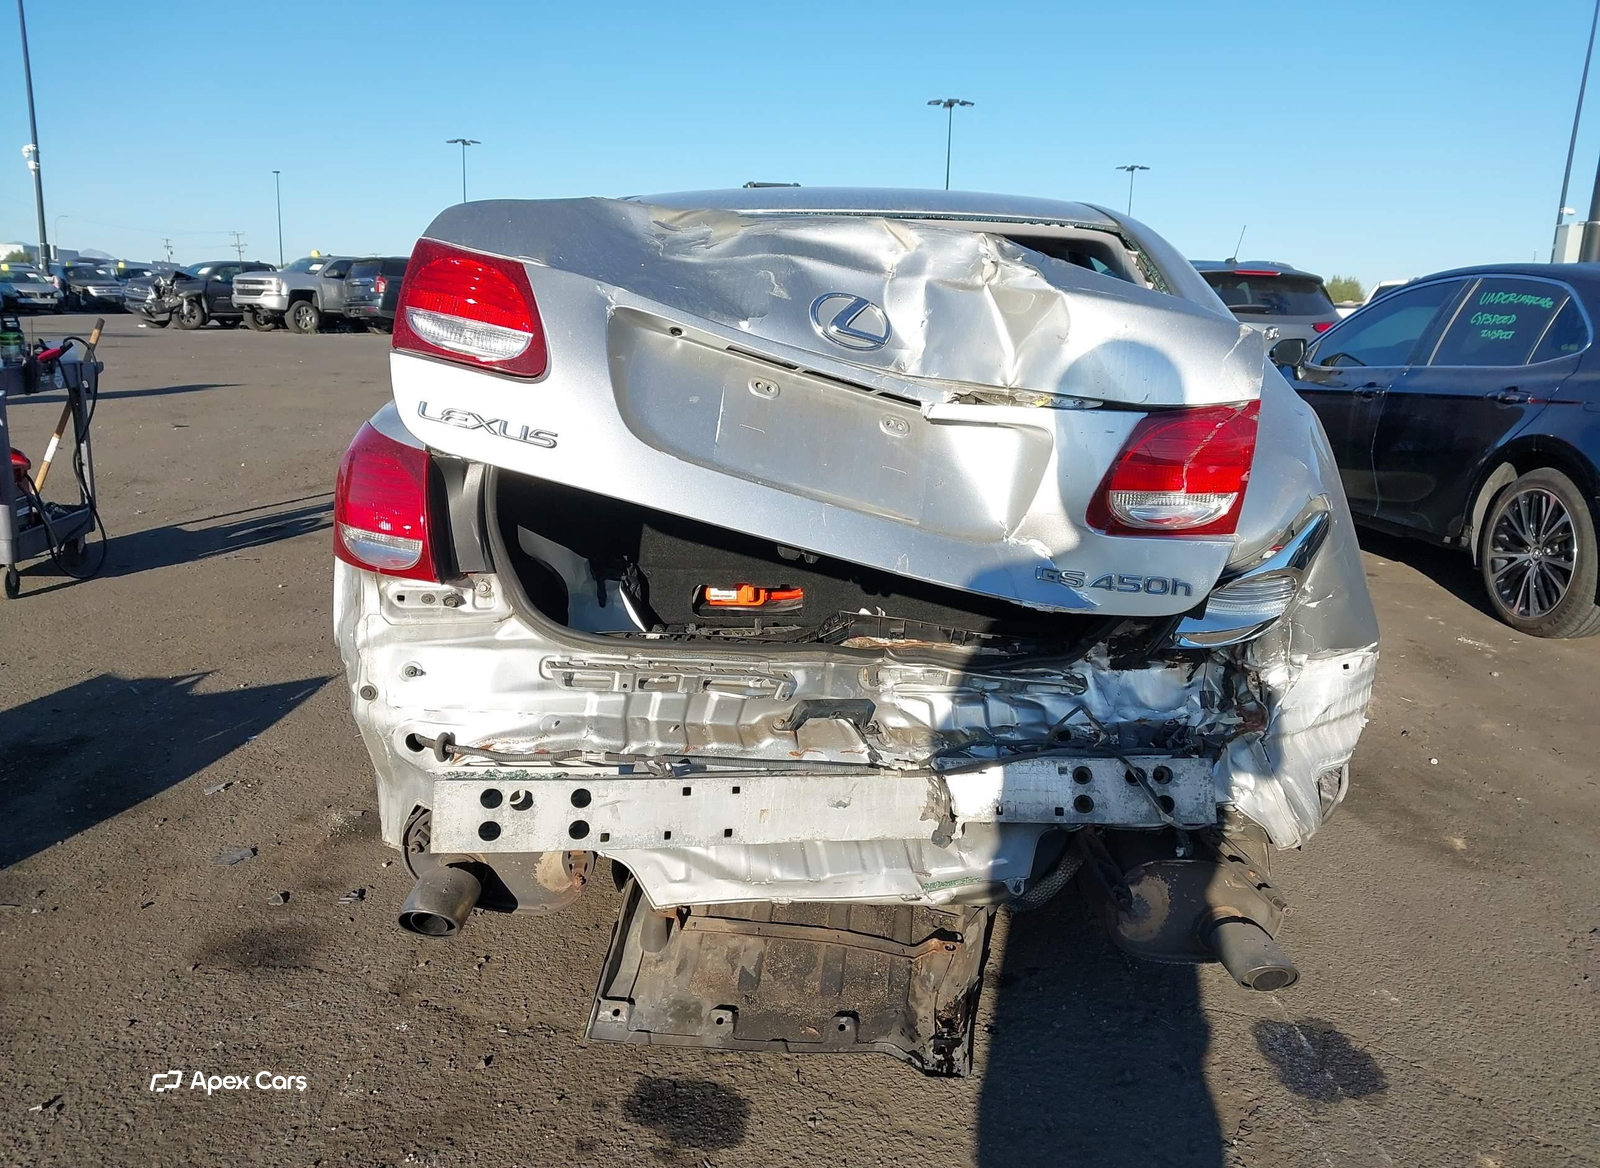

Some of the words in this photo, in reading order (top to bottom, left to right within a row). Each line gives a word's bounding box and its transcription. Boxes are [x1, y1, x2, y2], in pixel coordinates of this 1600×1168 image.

[417, 400, 558, 449] LEXUS
[1035, 565, 1085, 588] GS
[1089, 572, 1193, 597] 450h
